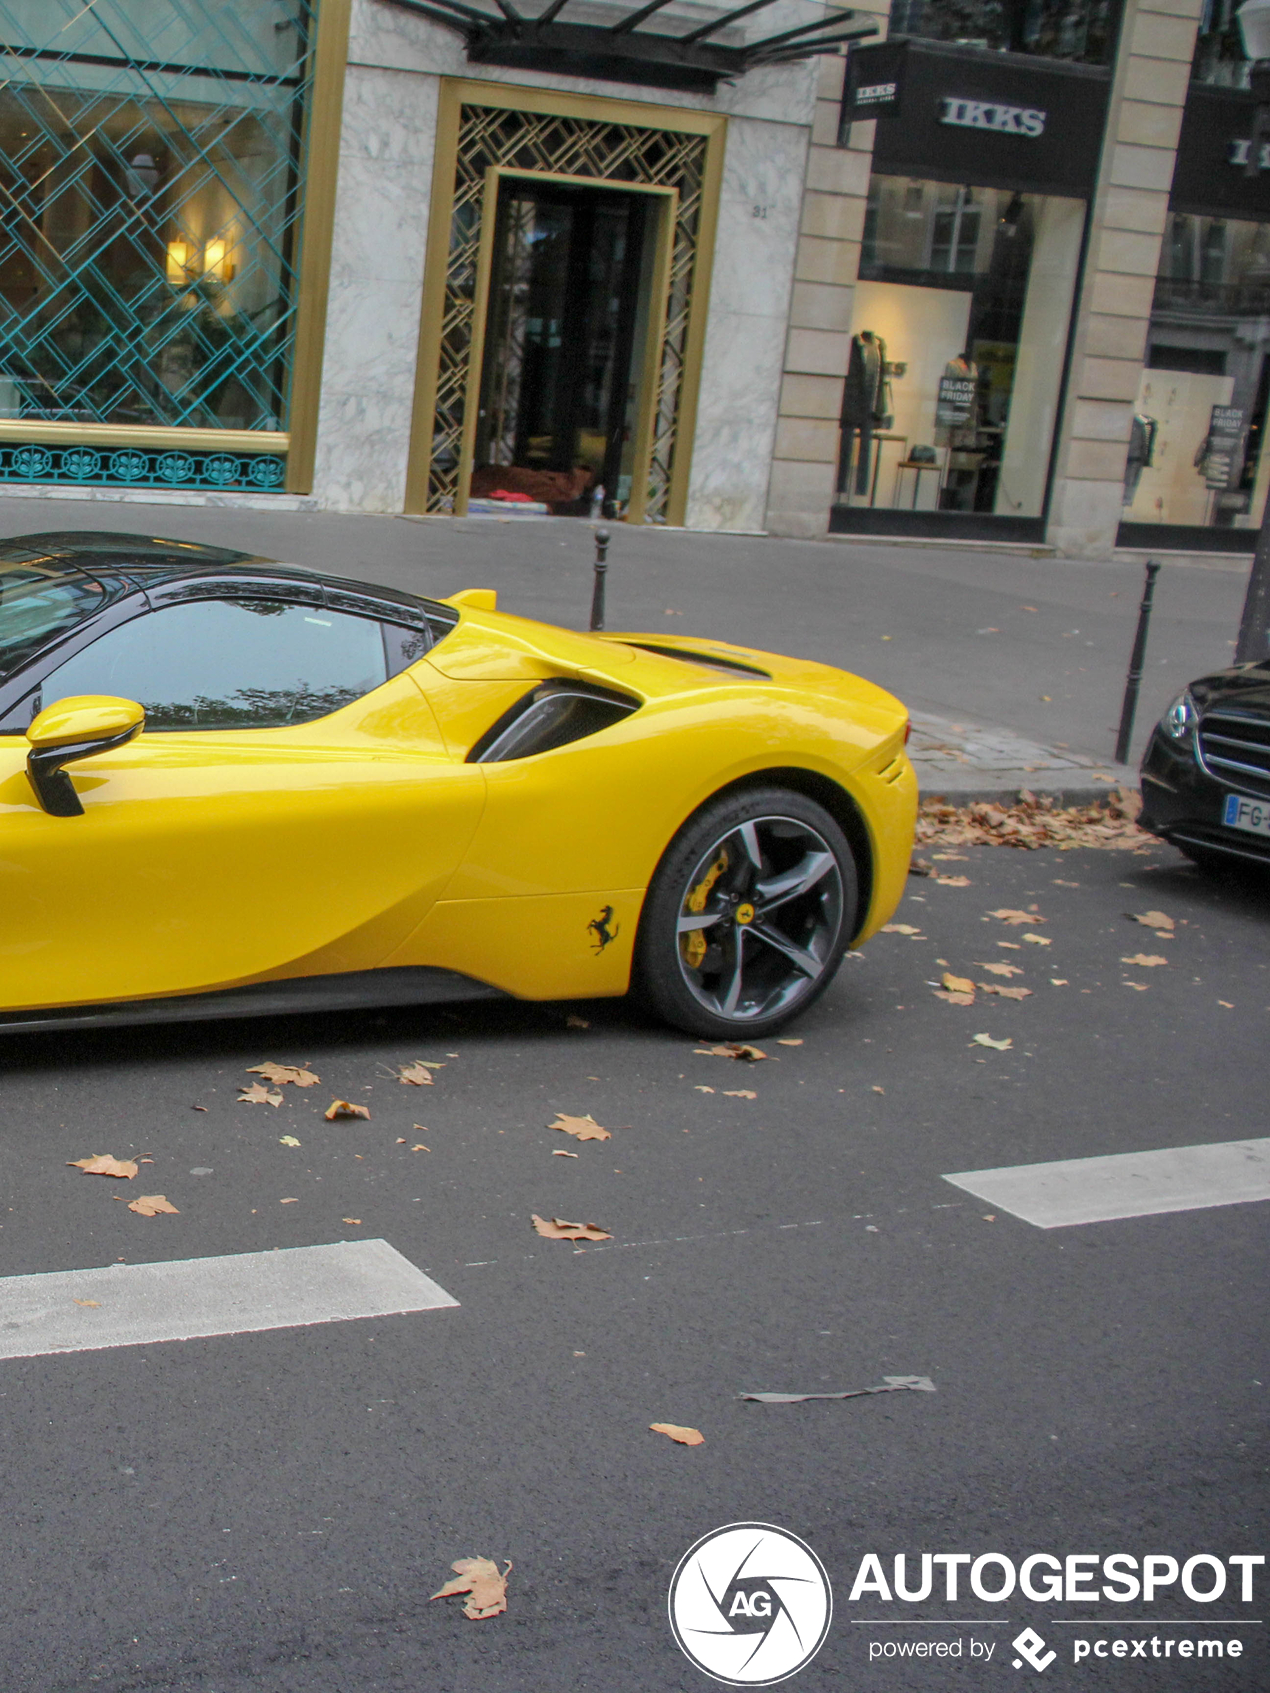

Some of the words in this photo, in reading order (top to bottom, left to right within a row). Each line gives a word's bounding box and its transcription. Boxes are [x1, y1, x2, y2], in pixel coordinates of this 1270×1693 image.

[857, 83, 896, 98] IKKS
[940, 97, 1046, 137] IKKS
[943, 379, 976, 391] BLACK
[941, 390, 975, 401] FRIDAY
[1215, 408, 1243, 418] BLACK
[1213, 417, 1242, 427] FRIDAY
